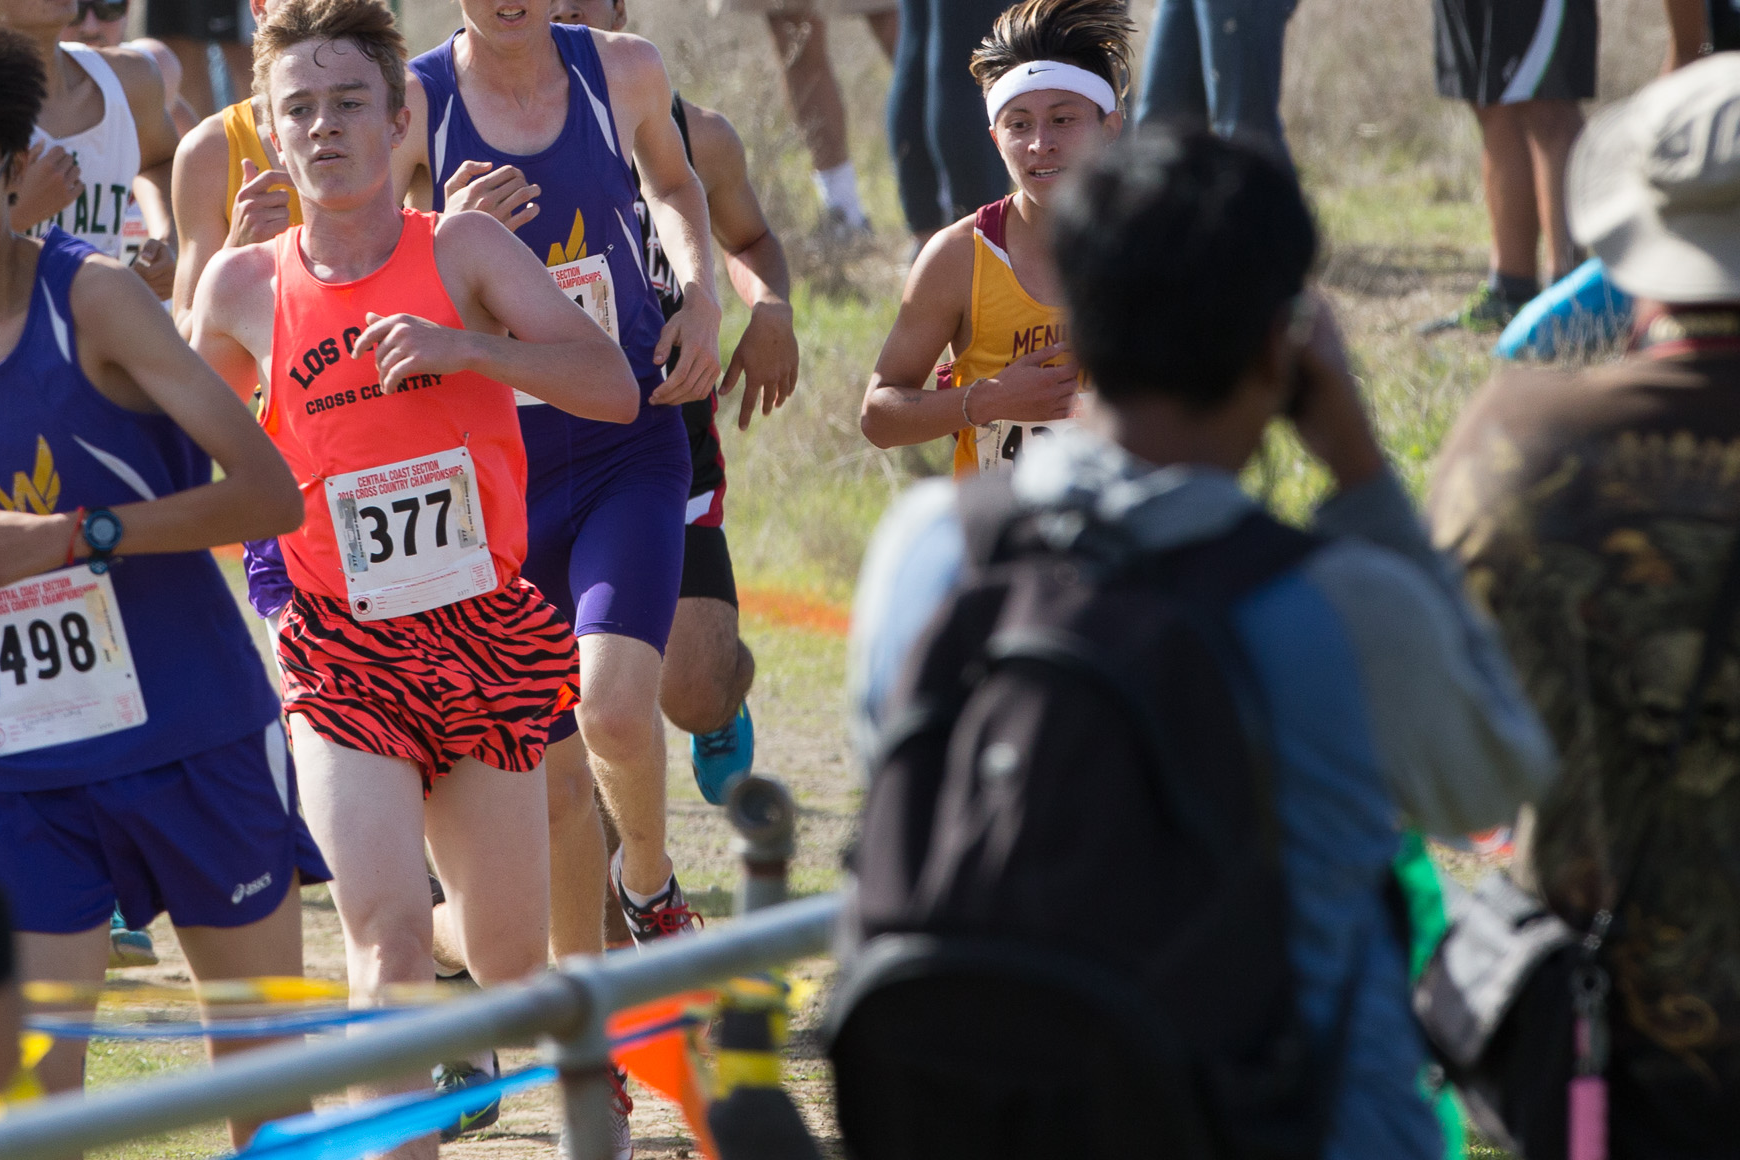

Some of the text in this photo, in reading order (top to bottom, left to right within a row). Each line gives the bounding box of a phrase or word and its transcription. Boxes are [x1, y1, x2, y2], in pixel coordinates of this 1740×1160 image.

[556, 265, 580, 281] SECTION
[289, 337, 341, 390] LOS
[305, 373, 442, 415] CROSS CONTRY
[337, 465, 465, 501] 2016 CROSS COUNTRY CHAMPIONSHIPS
[357, 460, 440, 488] CENTRAL COAST SECTION
[358, 489, 452, 563] 377
[0, 611, 96, 686] 498
